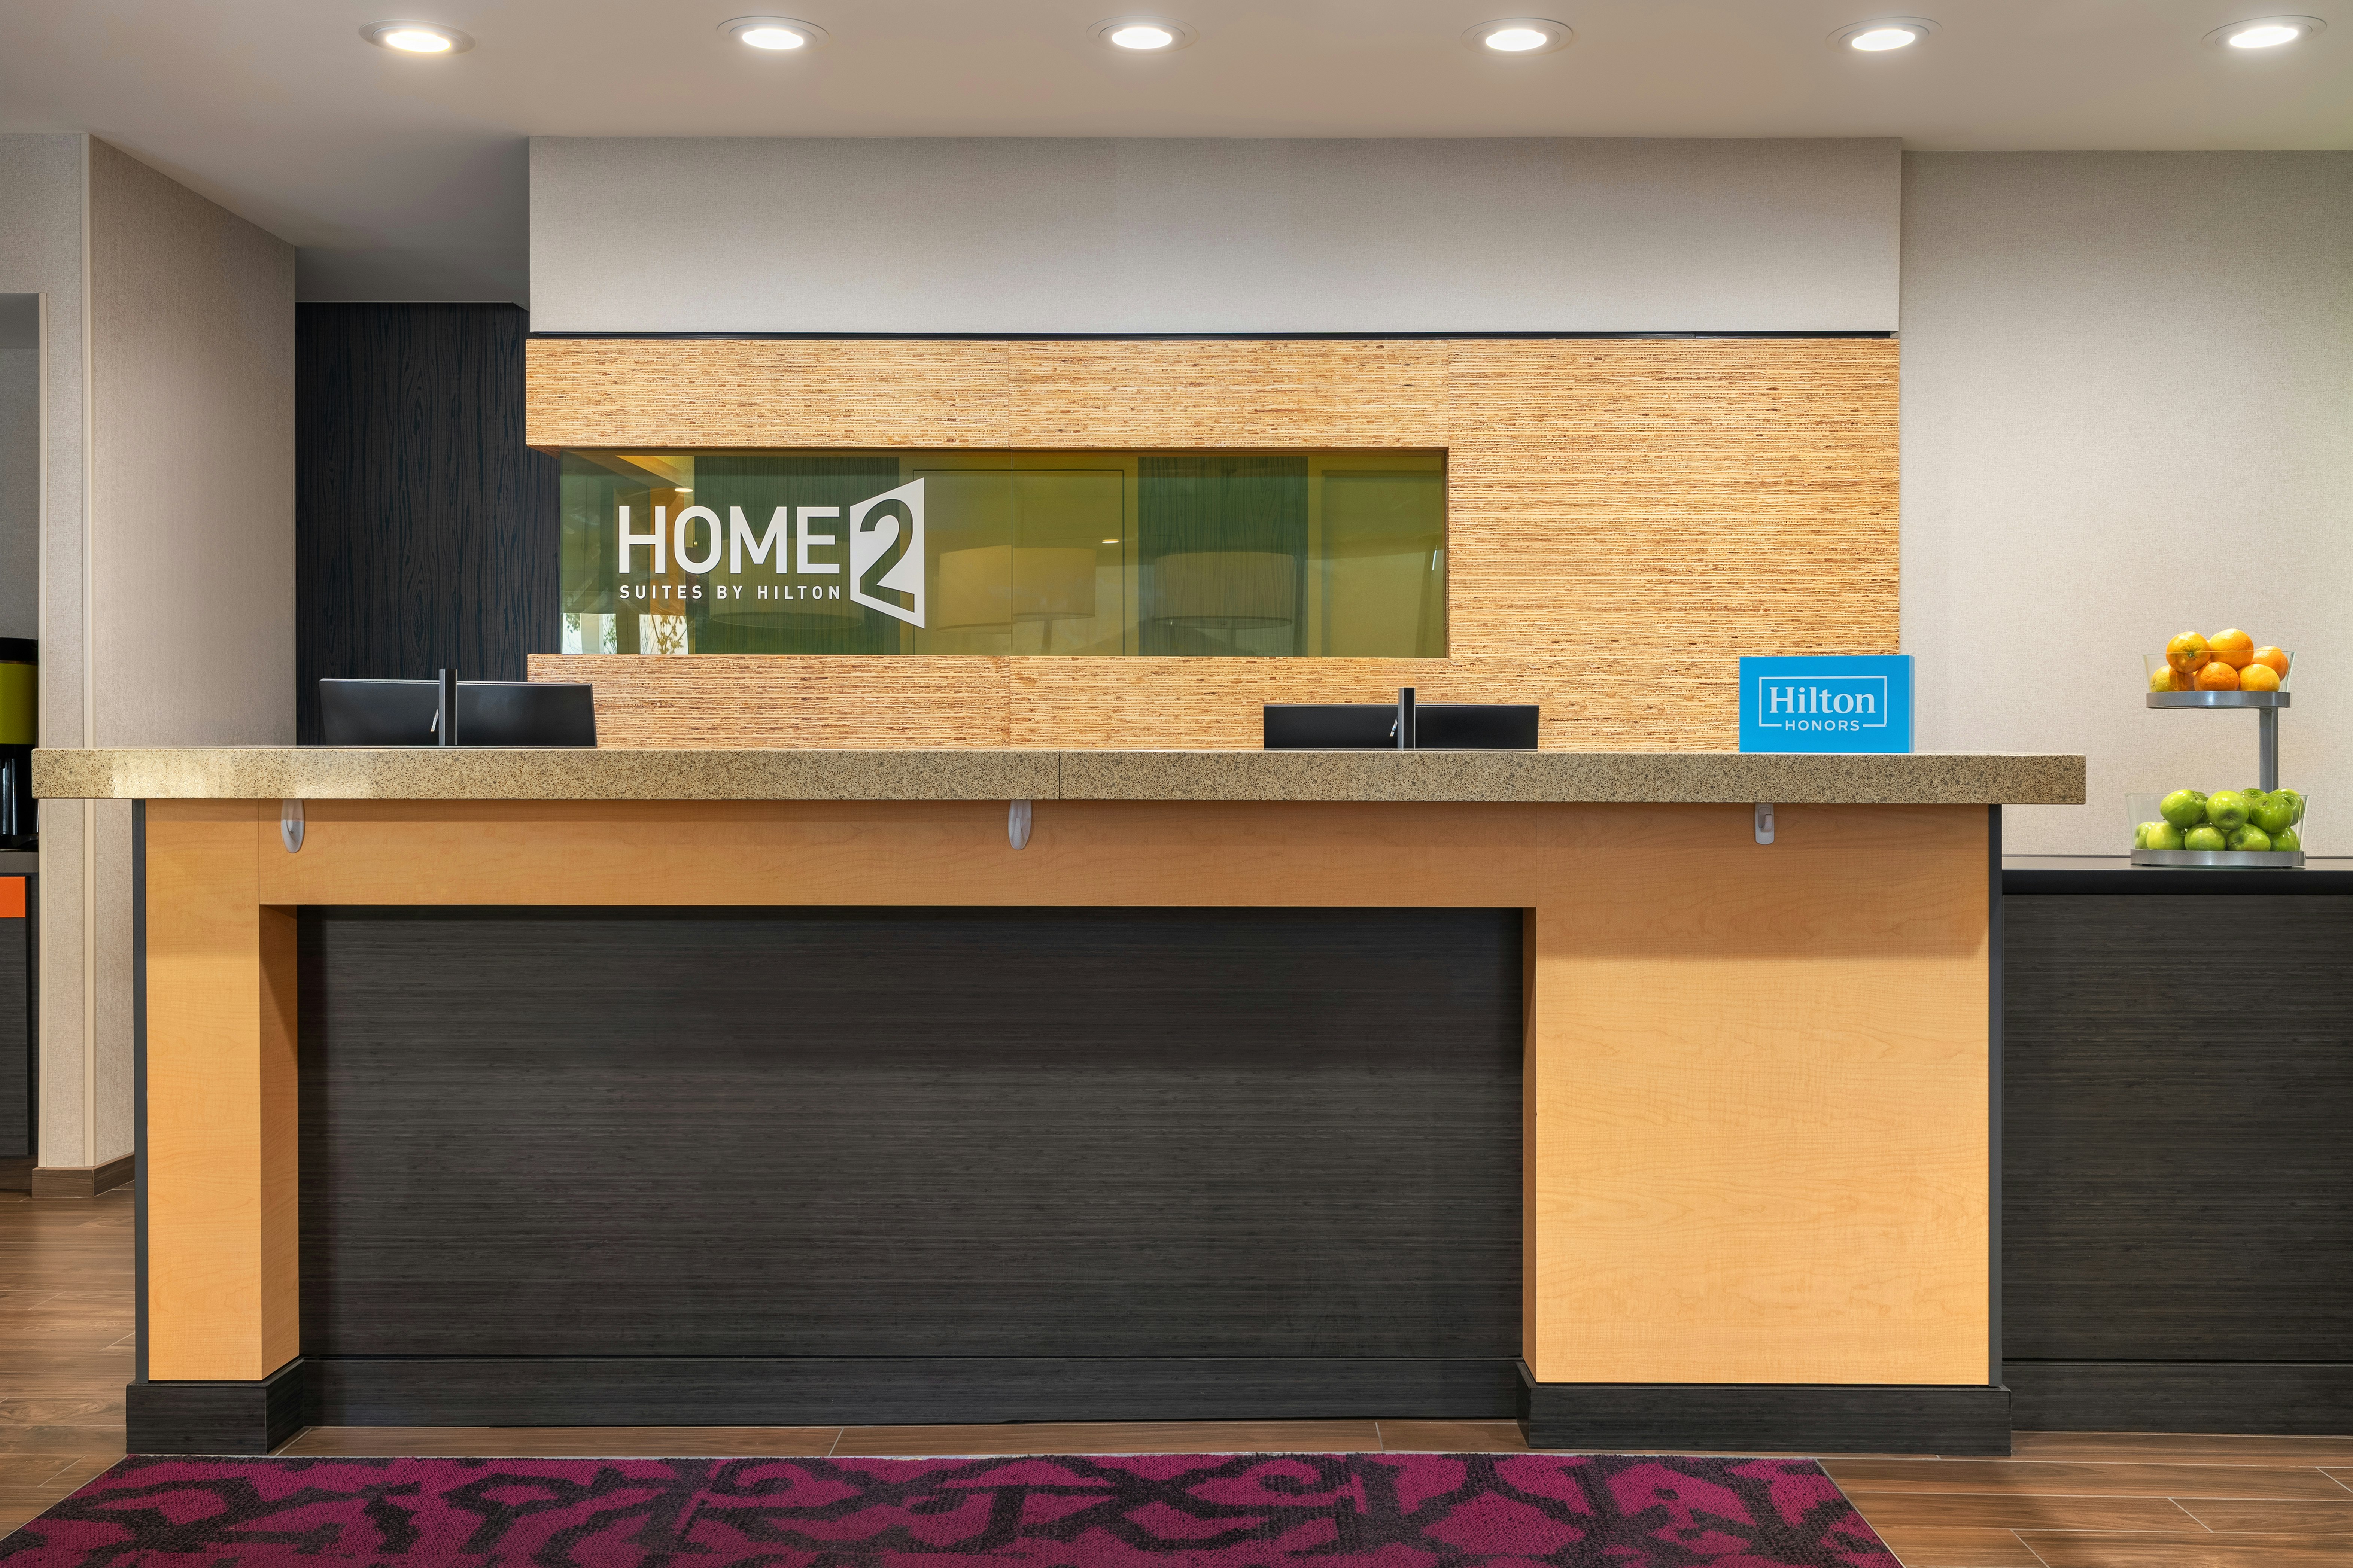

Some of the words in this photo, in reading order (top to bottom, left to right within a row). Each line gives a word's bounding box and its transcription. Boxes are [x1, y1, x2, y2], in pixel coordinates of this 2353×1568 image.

[619, 585, 702, 599] SUITES
[717, 585, 743, 599] BY
[757, 585, 840, 600] HILTON
[1769, 686, 1876, 714] Hilton
[1785, 719, 1860, 731] HONORS
